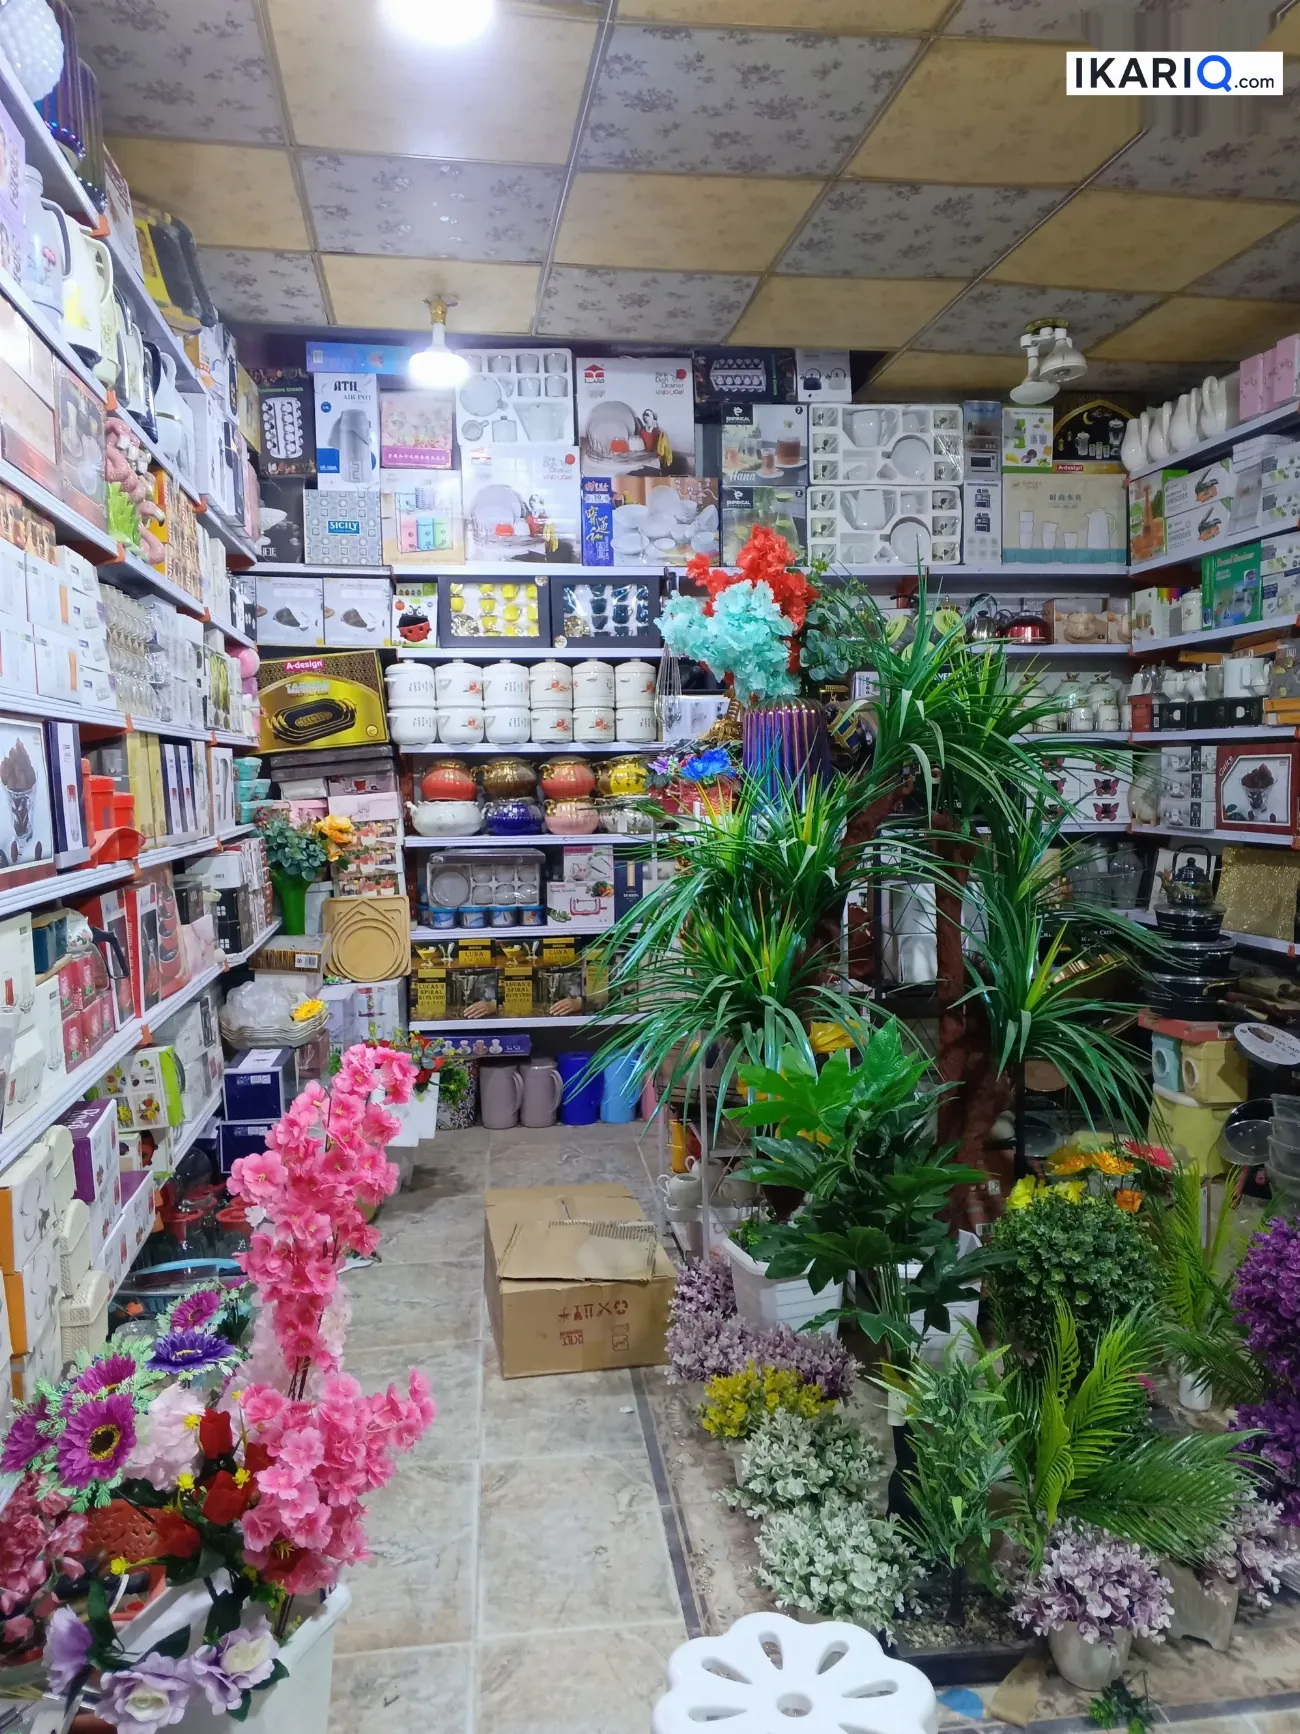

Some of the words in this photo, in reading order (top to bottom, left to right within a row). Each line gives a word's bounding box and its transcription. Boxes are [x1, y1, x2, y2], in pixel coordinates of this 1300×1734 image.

[333, 380, 358, 392] ATH
[1058, 464, 1083, 472] A-design
[730, 470, 757, 482] Hana
[329, 521, 359, 530] SICILY
[286, 660, 323, 670] A-design
